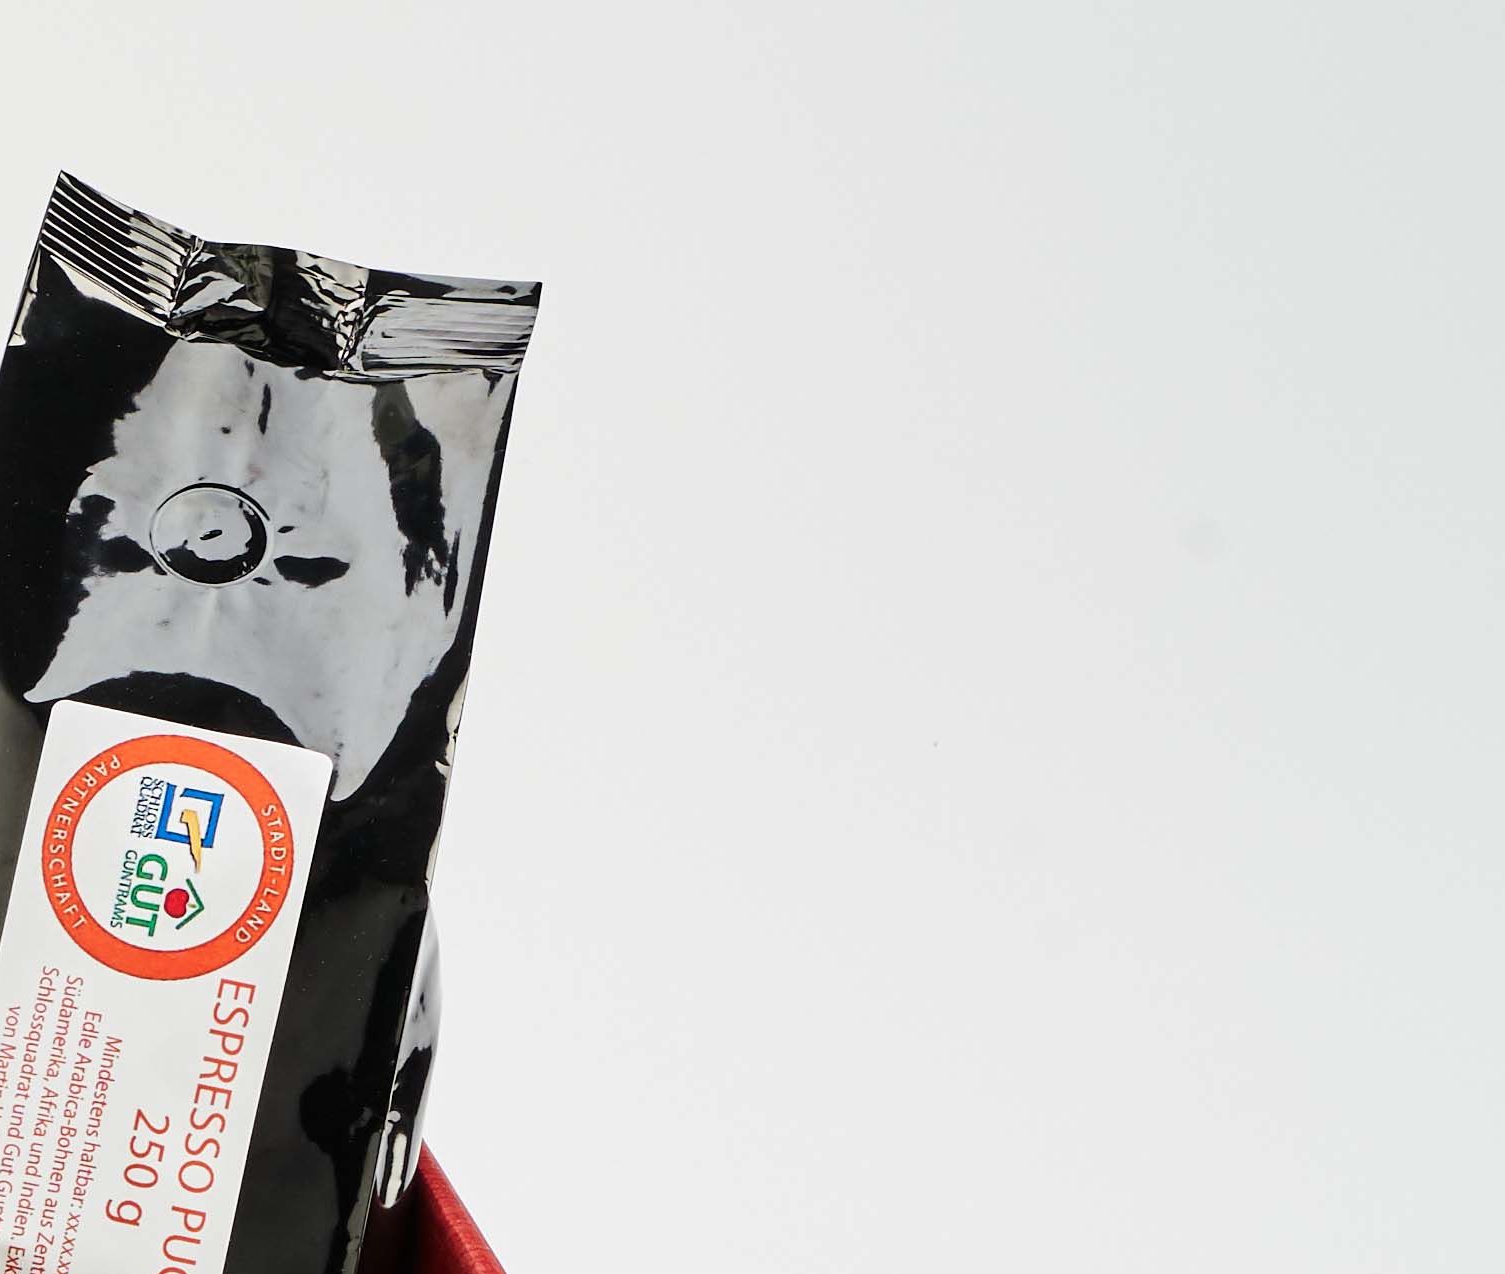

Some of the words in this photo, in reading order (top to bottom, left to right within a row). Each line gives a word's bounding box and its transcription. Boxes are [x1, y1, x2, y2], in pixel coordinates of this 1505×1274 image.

[130, 776, 153, 838] QUADRAT
[142, 777, 165, 840] SCHLOSS
[48, 754, 122, 929] PARTNERSCHAFT
[235, 804, 288, 944] STADT-LAND
[109, 849, 138, 929] GUNTRAMS
[125, 853, 169, 937] GUT
[2, 1005, 21, 1038] von
[13, 965, 60, 1100] Schlossquadrat
[42, 975, 84, 1082] Südamerika,
[77, 1010, 102, 1049] Edle
[32, 1086, 58, 1137] Afrika
[84, 1035, 122, 1137] Mindestens
[176, 978, 256, 1194] ESPRESSO
[6, 1103, 25, 1140] und
[46, 1052, 92, 1193] Arabica-Bohnen
[122, 1108, 170, 1189] 250
[24, 1142, 43, 1178] und
[69, 1141, 101, 1209] haltbar:
[9, 1181, 39, 1240] Indien.
[39, 1197, 57, 1228] aus
[104, 1198, 142, 1227] g
